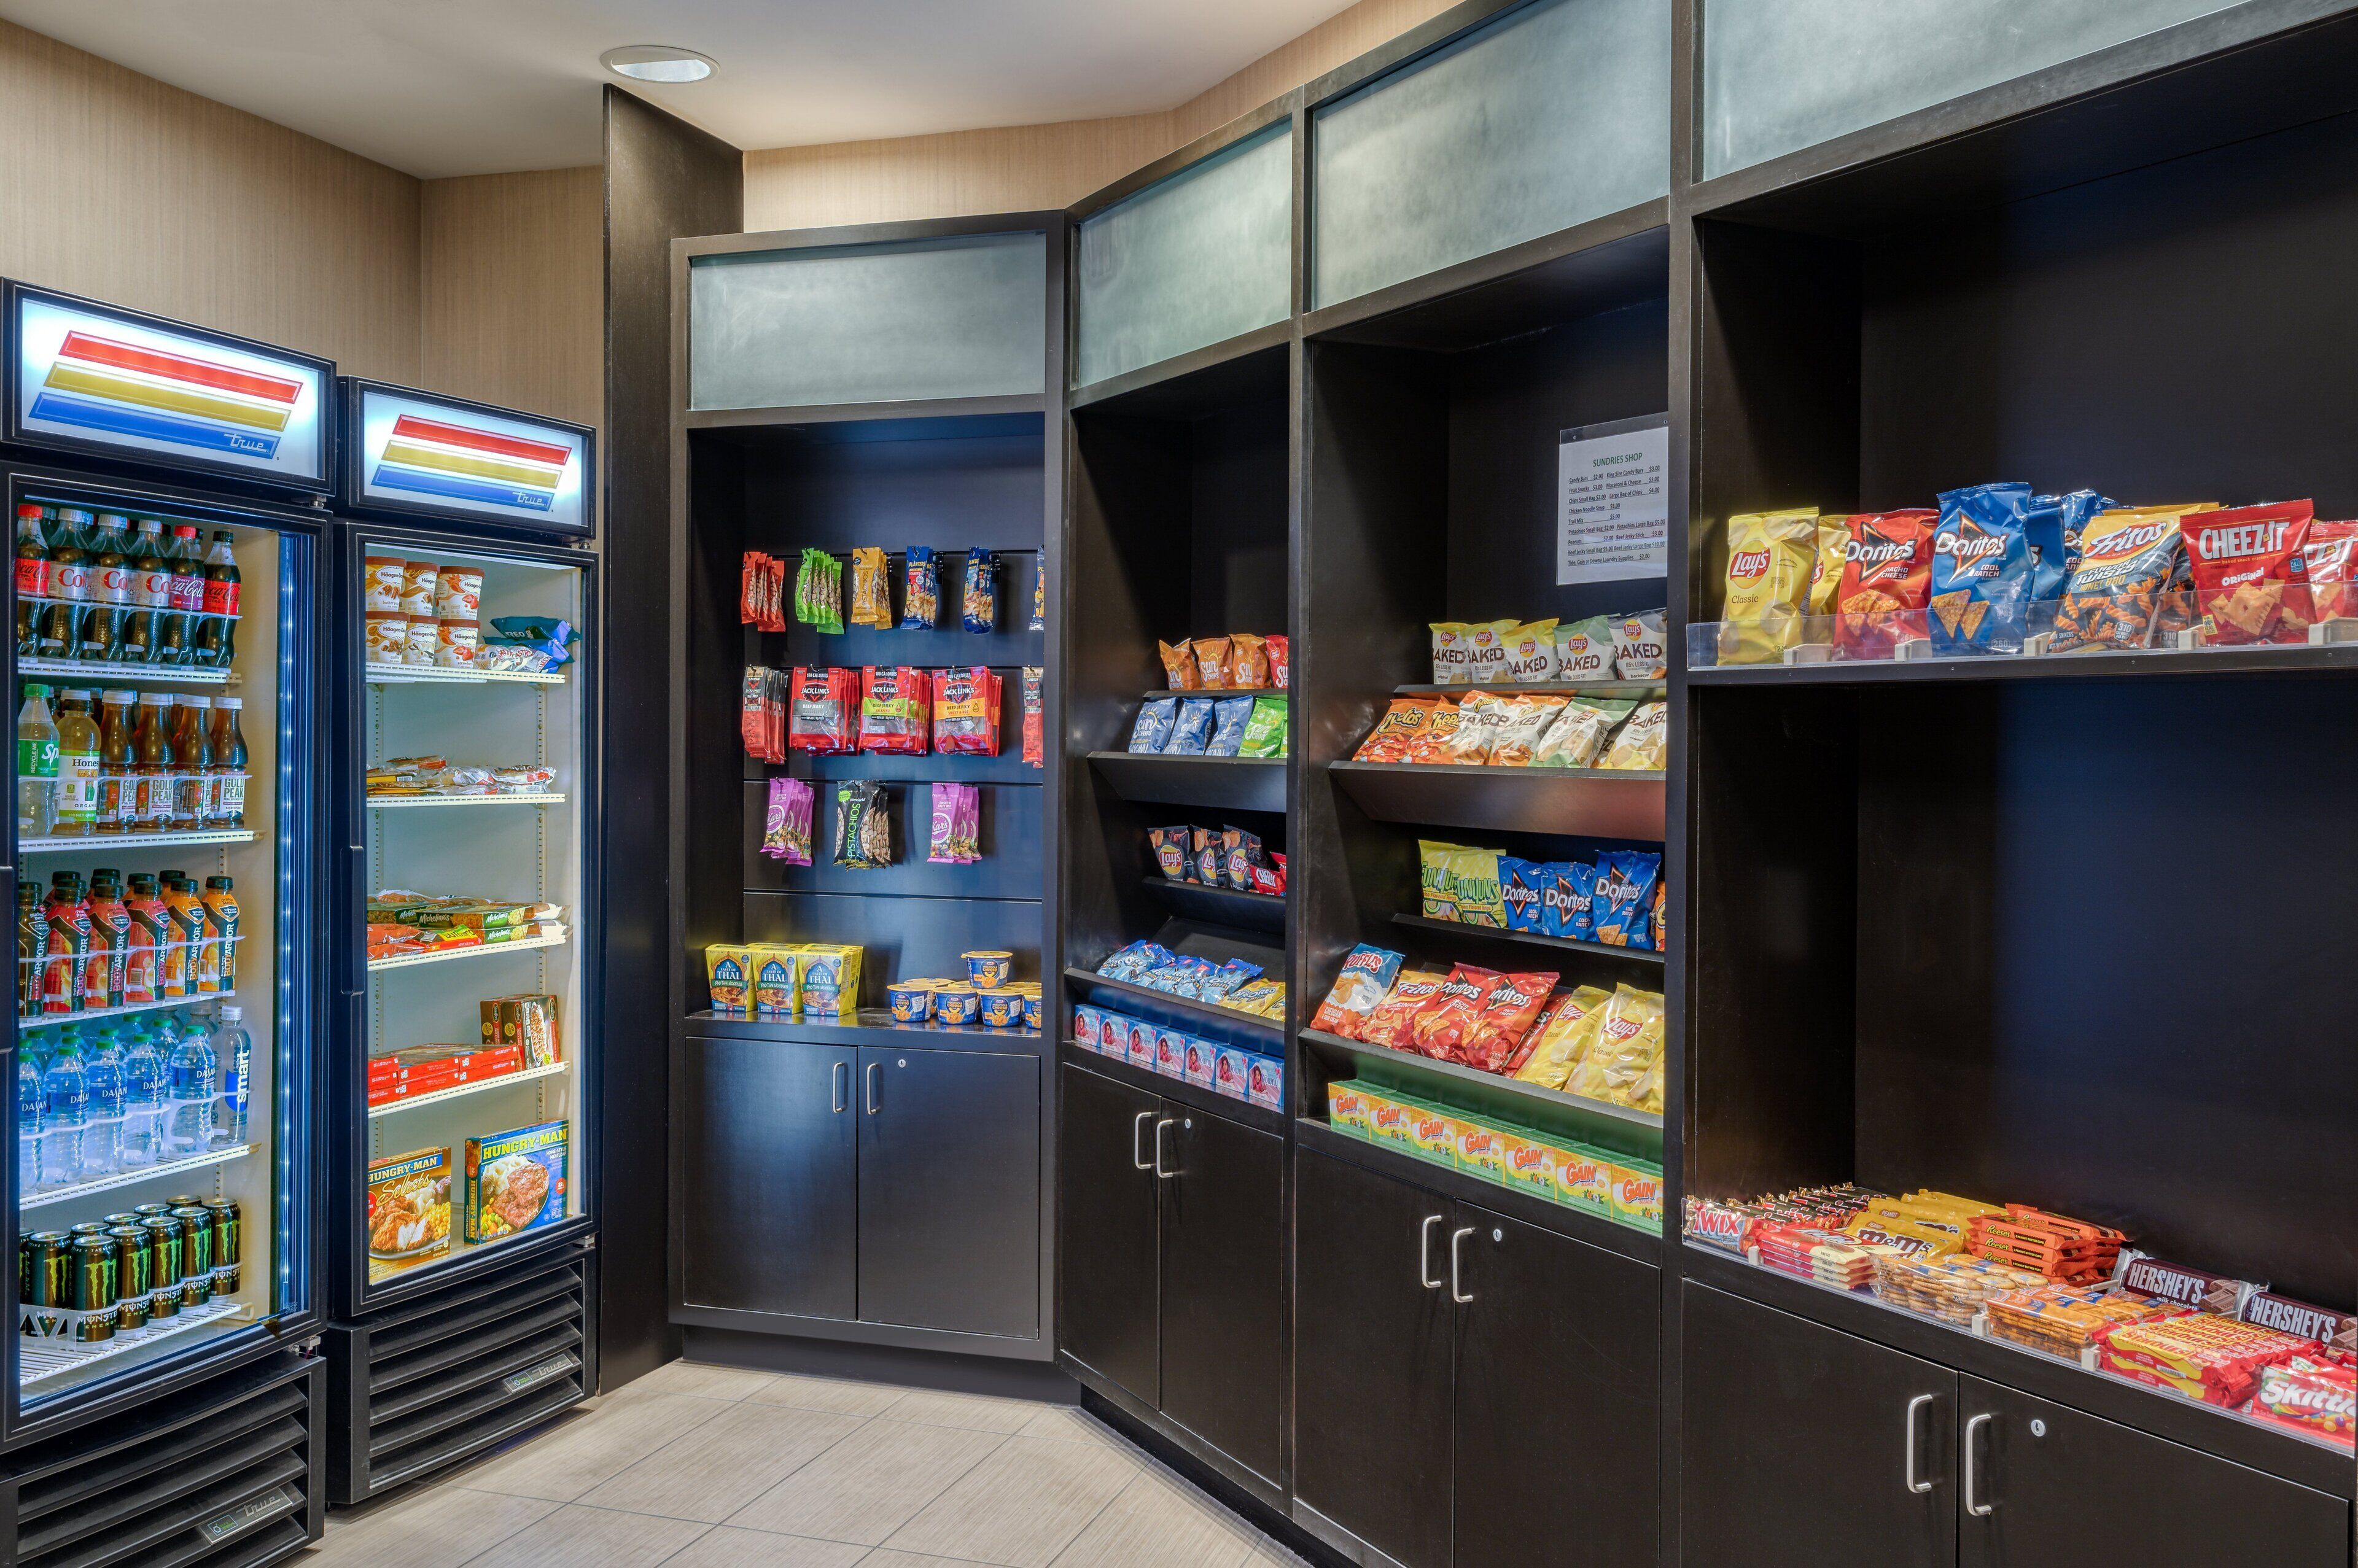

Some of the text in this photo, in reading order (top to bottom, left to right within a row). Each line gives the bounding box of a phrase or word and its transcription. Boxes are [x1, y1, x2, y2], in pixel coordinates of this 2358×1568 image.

[1593, 452, 1643, 467] SUNDRIES SHOP
[1936, 532, 2009, 556] Doritos
[2085, 522, 2166, 558] Fritos
[1846, 541, 1916, 562] Doritos
[1732, 551, 1768, 578] Lay's
[2077, 560, 2138, 585] TWISTS
[2088, 559, 2131, 575] FLAVOR
[2079, 575, 2125, 591] HONEY BBQ
[1732, 594, 1759, 604] Classic
[1625, 624, 1640, 635] Lay's
[2119, 623, 2131, 632] 310
[1476, 632, 1492, 642] Lay's
[1571, 638, 1587, 650] Lay's
[153, 780, 173, 790] GOLD
[152, 791, 172, 801] PEAK
[847, 803, 861, 857] PISTACHIOS
[1161, 850, 1181, 867] Lay's
[1503, 885, 1539, 901] Doritos
[1596, 879, 1641, 899] Doritos
[1546, 890, 1591, 910] Doritos
[419, 914, 449, 923] Michelina's
[486, 912, 508, 923] Michelina's
[488, 930, 510, 940] Michelina's
[1343, 953, 1382, 973] RUFFLES
[1395, 982, 1438, 998] Fritos
[1441, 982, 1482, 999] Doritos
[1324, 1007, 1342, 1019] CHEDDAR
[1140, 1037, 1153, 1049] Downy
[1168, 1045, 1182, 1057] Downy
[1593, 1046, 1613, 1058] Classic
[1197, 1054, 1212, 1068] Downy
[237, 1049, 250, 1103] smart
[1229, 1063, 1244, 1077] Downy
[1261, 1073, 1278, 1088] Downy
[1336, 1094, 1357, 1114] GAIN
[1377, 1106, 1400, 1127] GAIN
[1420, 1119, 1444, 1140] GAIN
[483, 1128, 567, 1160] HUNGRY-MAN
[1465, 1133, 1492, 1154] GAIN
[1514, 1146, 1543, 1170] GAIN
[368, 1157, 437, 1183] HUNGRY-MAN
[1566, 1162, 1596, 1186] GAIN
[376, 1173, 430, 1206] Selects
[1623, 1179, 1656, 1203] GAIN
[1692, 1203, 1742, 1236] TWIX
[1987, 1224, 2010, 1238] Reese's
[1985, 1238, 2009, 1251] Reese's
[1984, 1251, 2007, 1265] Reese's
[2128, 1263, 2205, 1304] HERSHEY'S
[2170, 1300, 2198, 1311] chocolate
[2250, 1297, 2337, 1343] HERSHEY'S
